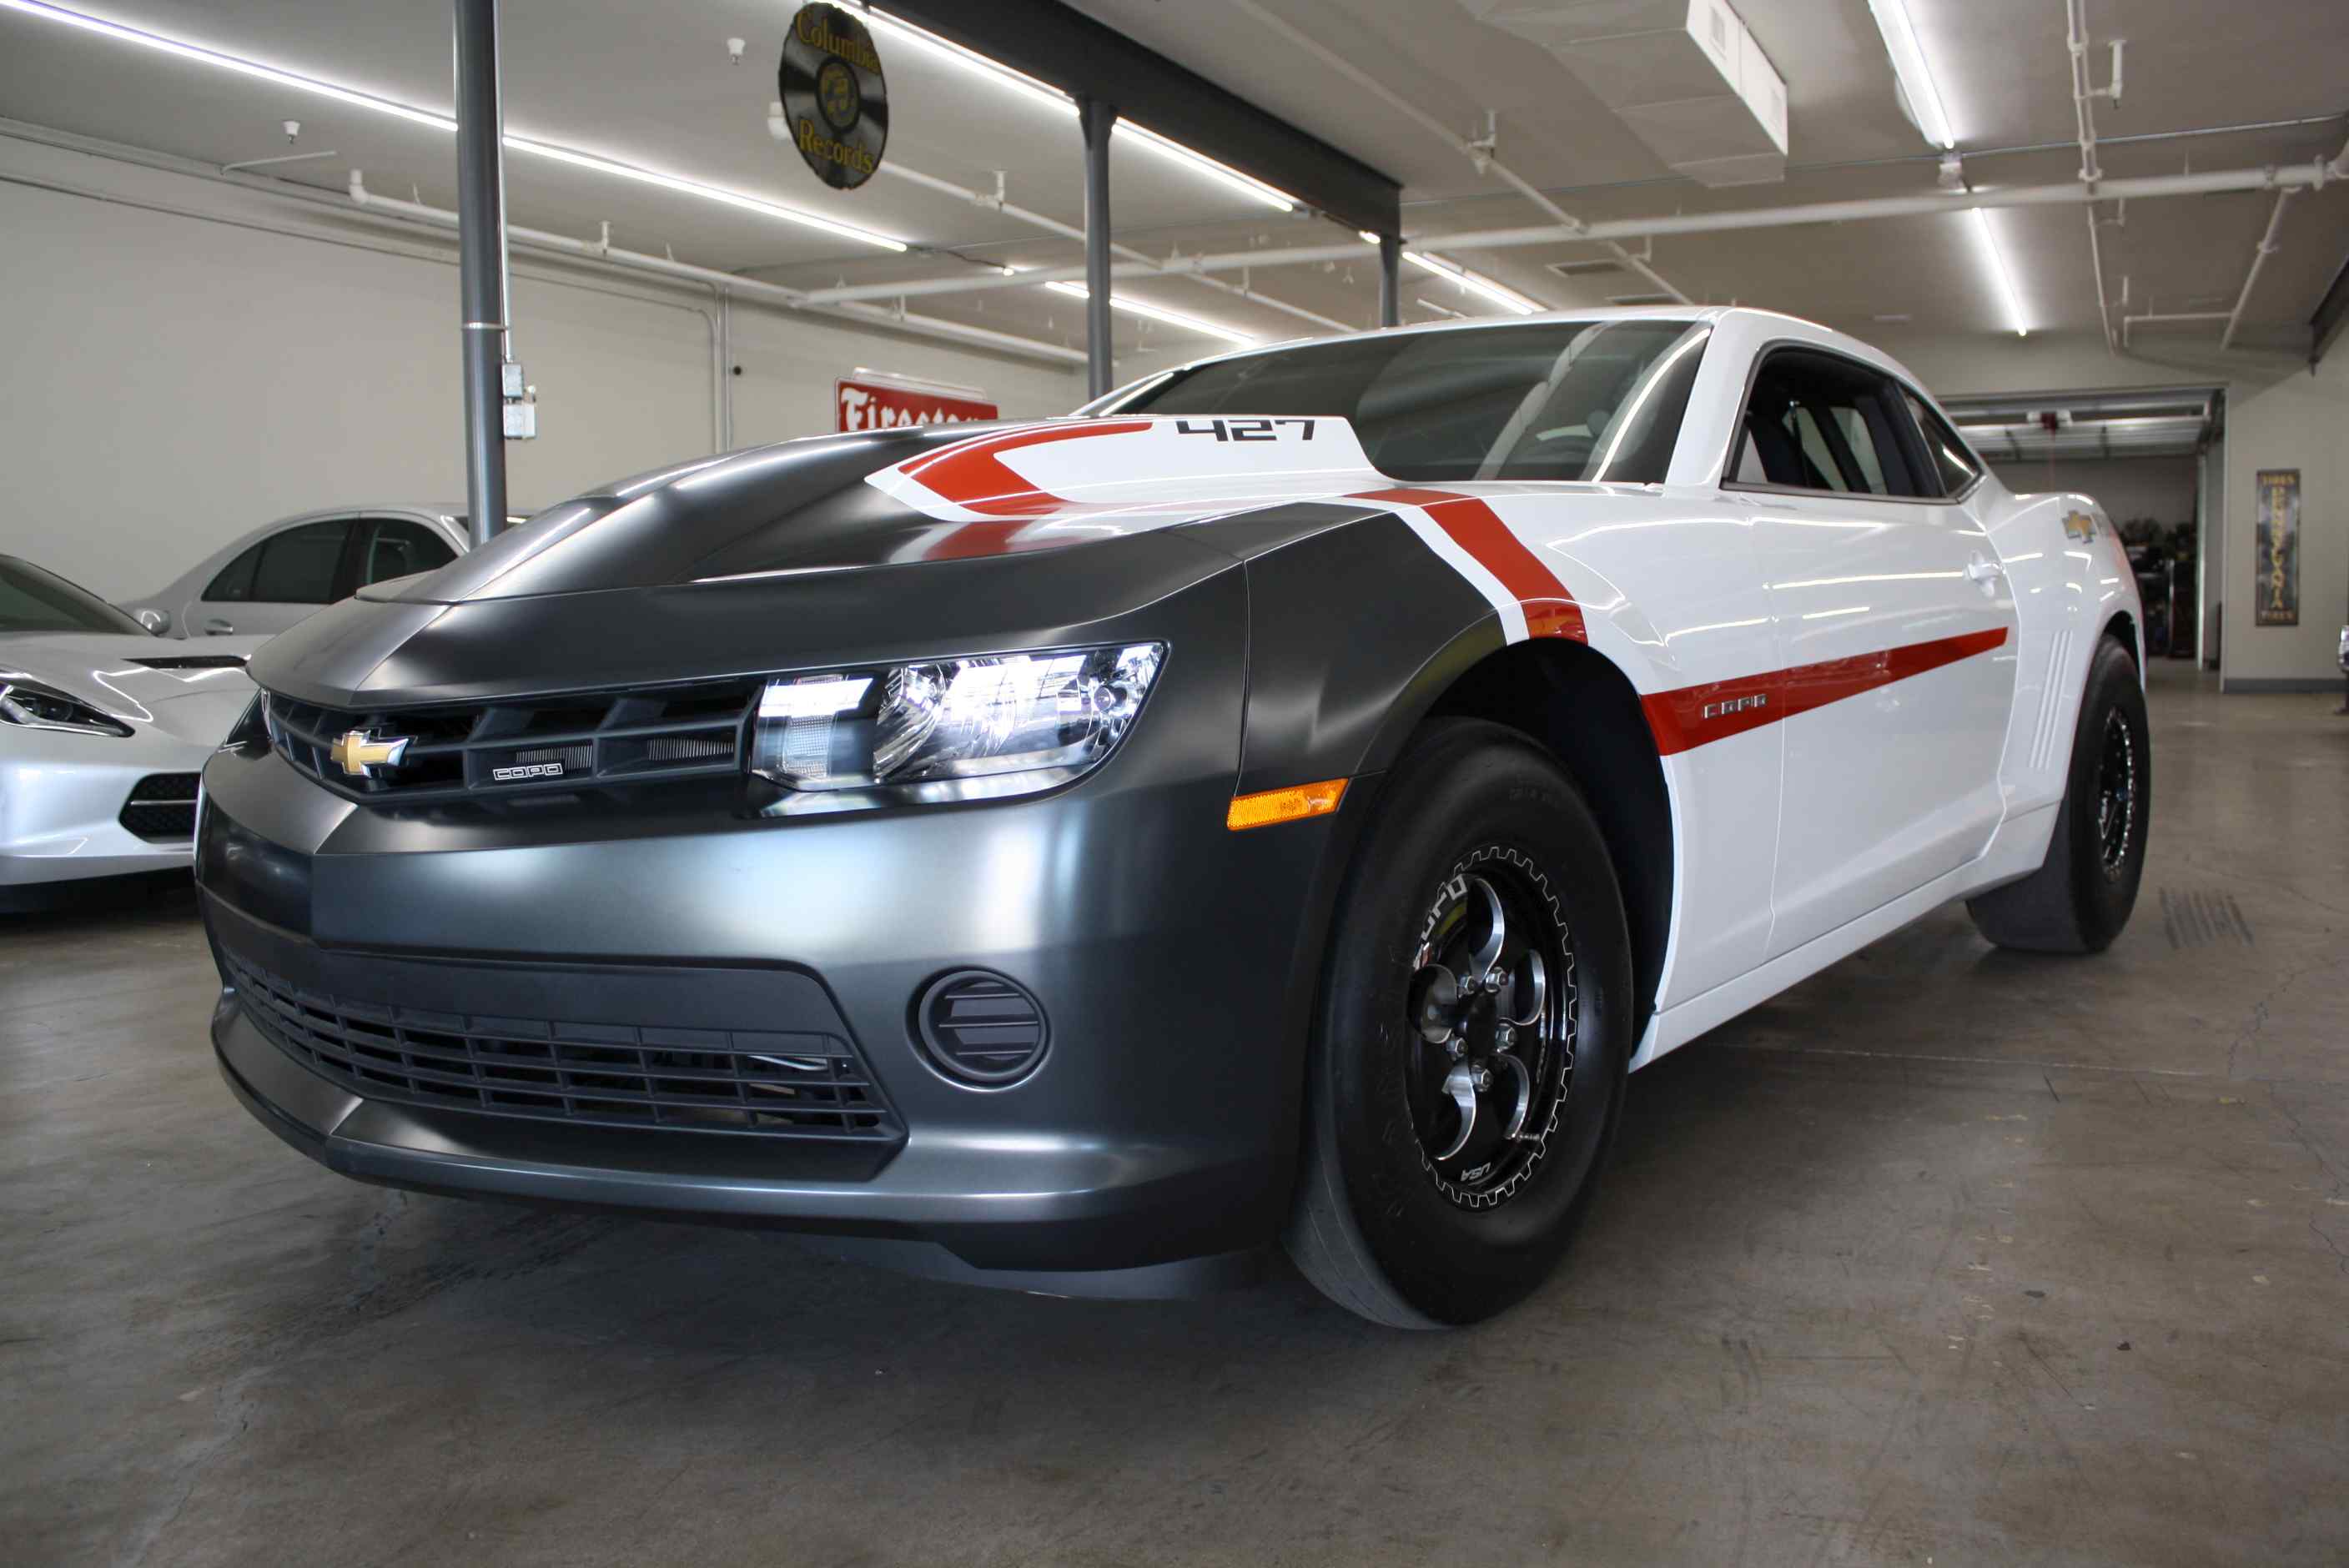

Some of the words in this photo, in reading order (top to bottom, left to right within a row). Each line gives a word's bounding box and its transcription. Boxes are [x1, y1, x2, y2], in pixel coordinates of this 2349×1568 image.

[796, 12, 882, 75] Columbia
[800, 118, 873, 174] Records
[841, 386, 978, 432] Fires
[1175, 419, 1315, 442] 427
[1703, 693, 1767, 719] COPO
[492, 762, 563, 781] COPO
[1460, 1162, 1491, 1181] USA
